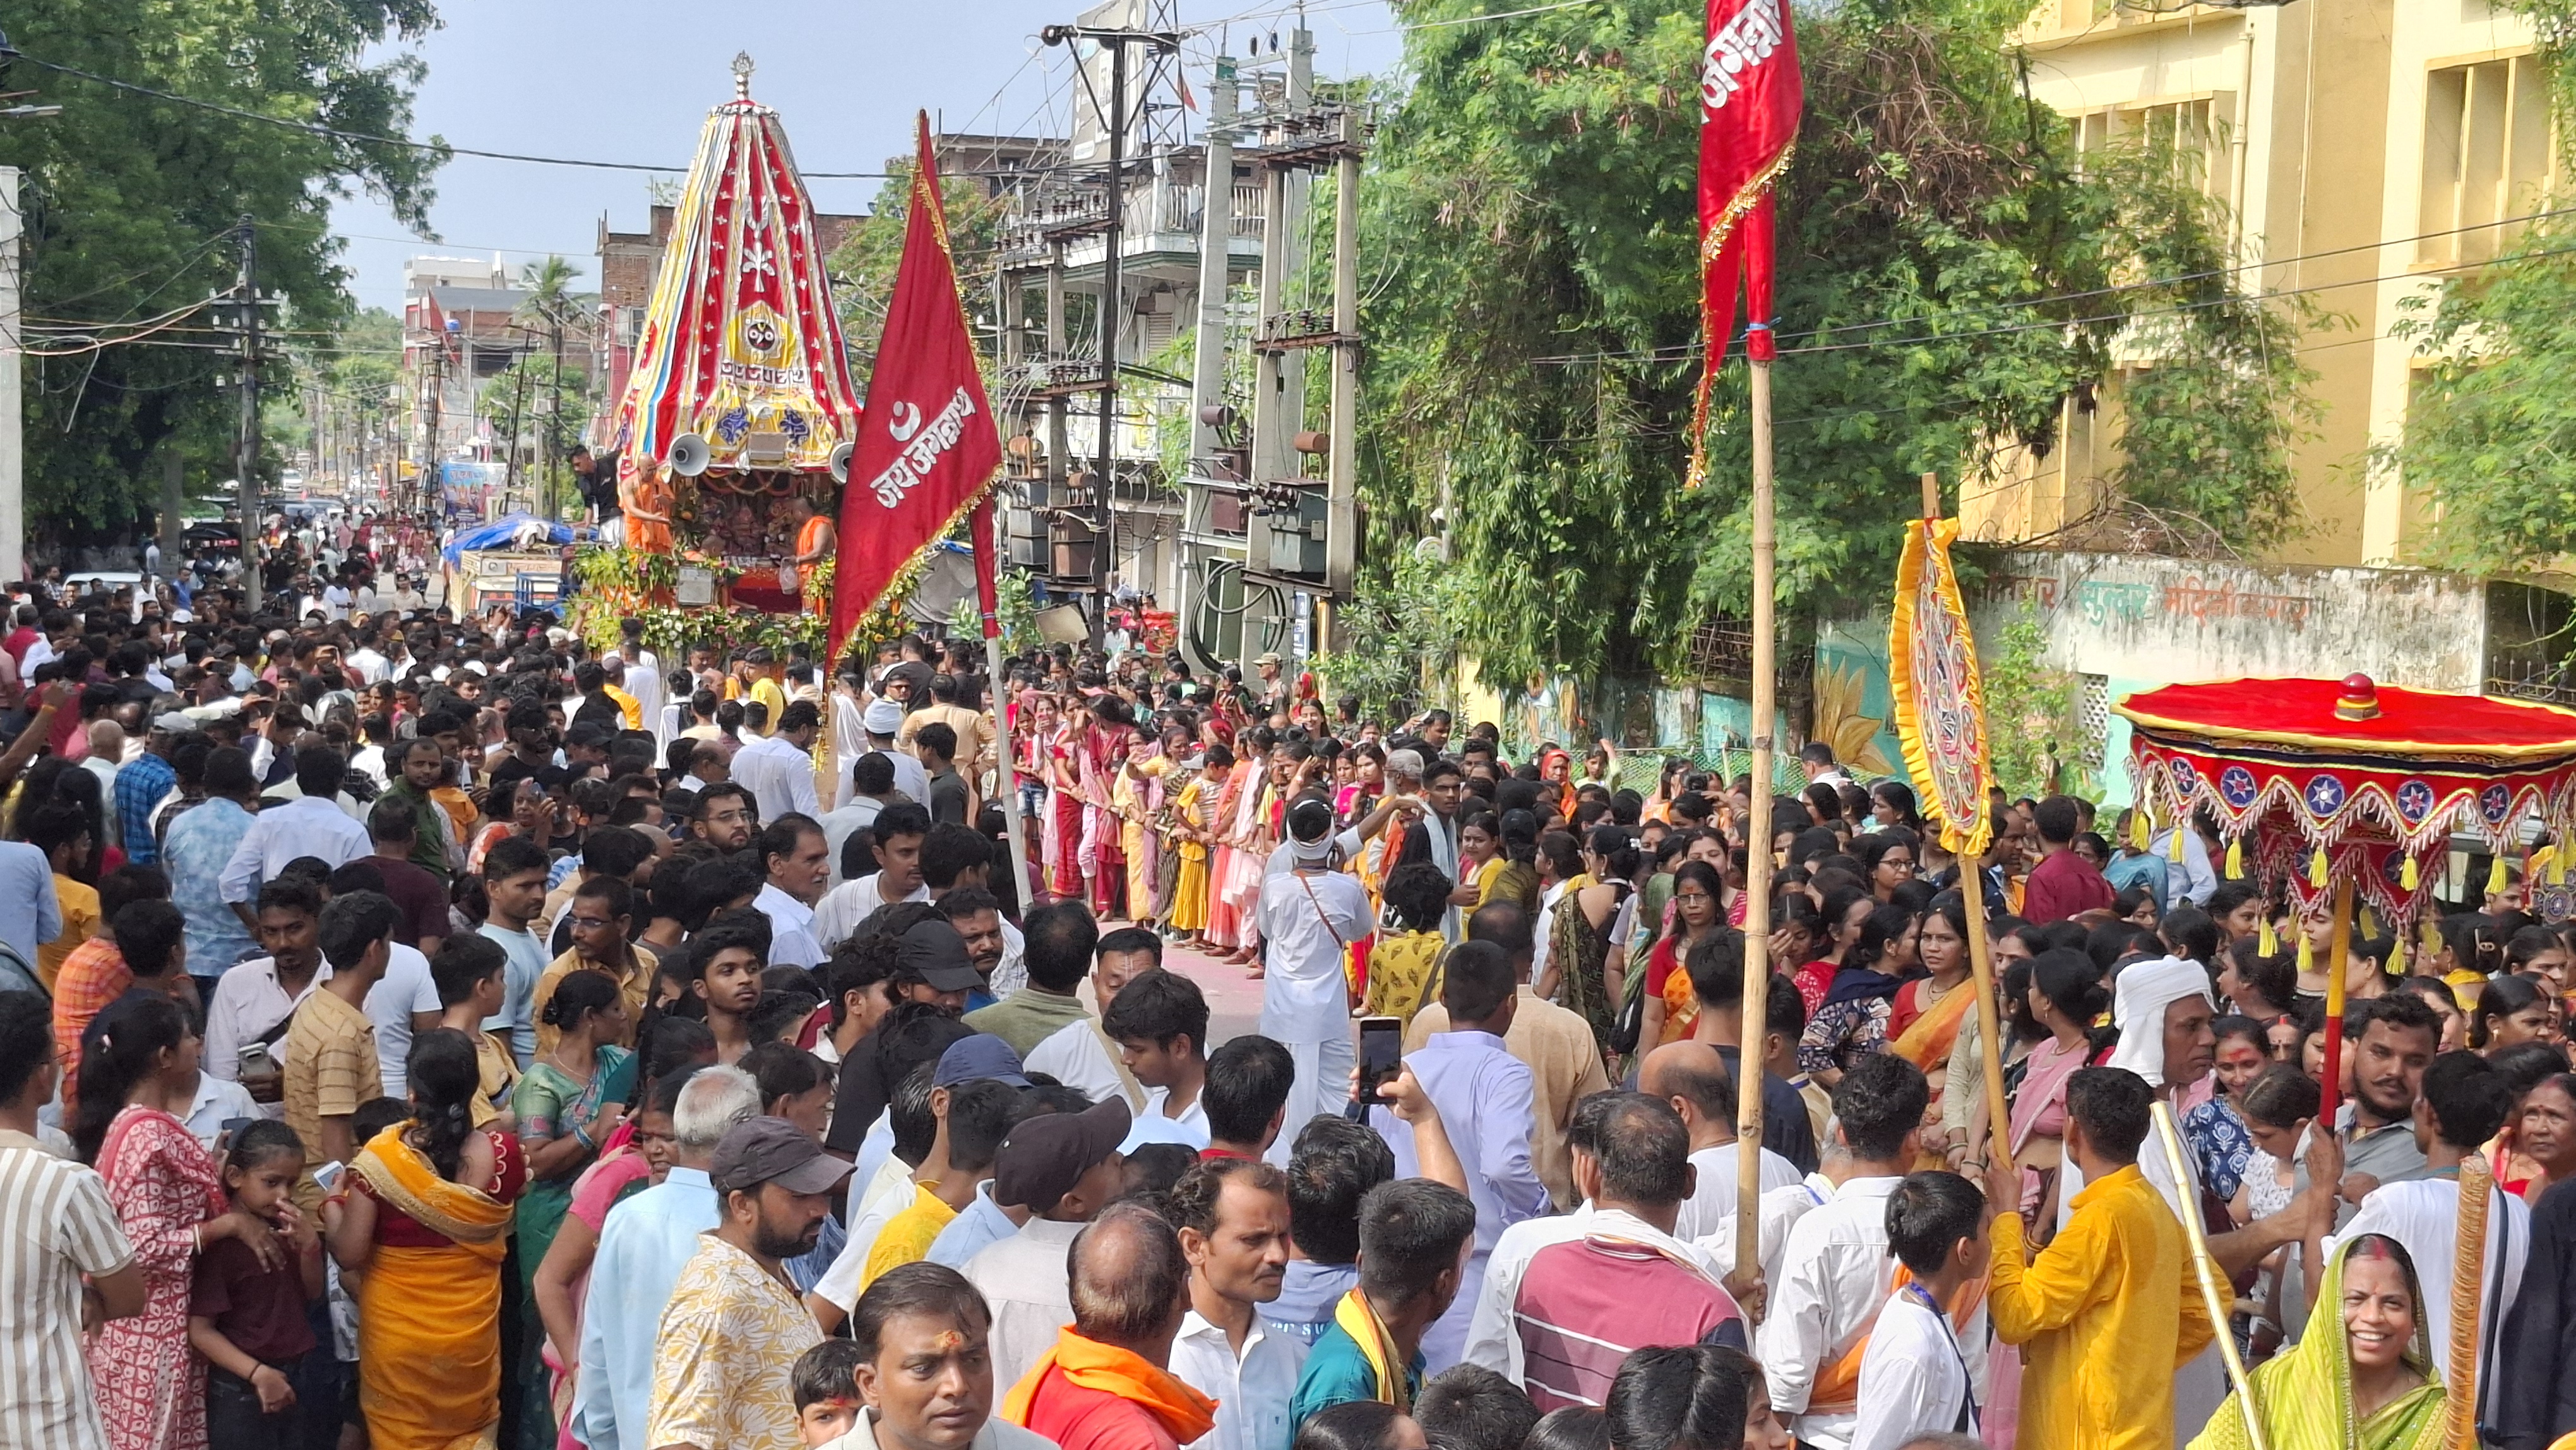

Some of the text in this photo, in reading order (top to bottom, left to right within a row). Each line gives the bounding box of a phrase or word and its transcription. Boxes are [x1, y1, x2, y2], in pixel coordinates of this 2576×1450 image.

[1702, 0, 1783, 109] जगन्ना
[869, 386, 977, 508] जय जगन्नाथ
